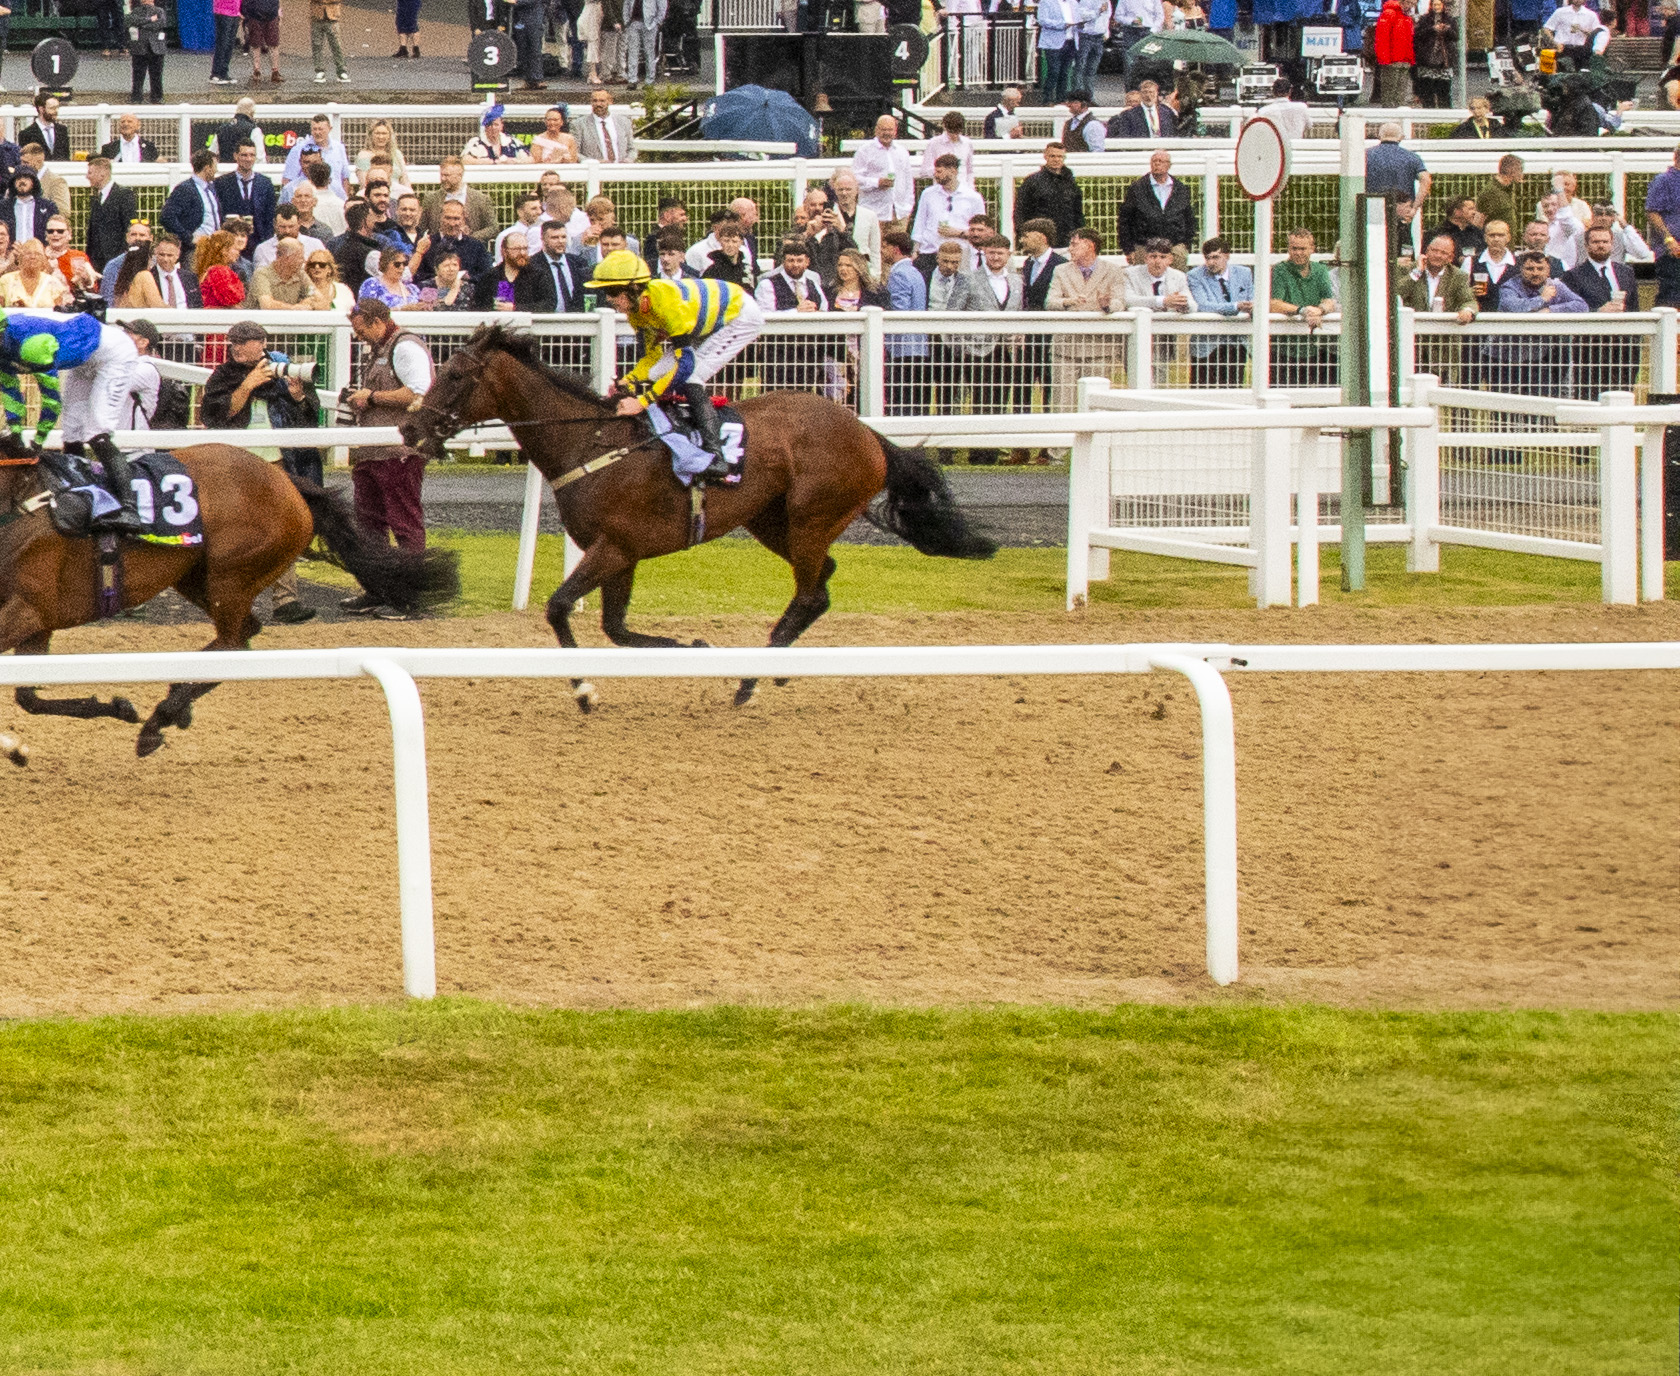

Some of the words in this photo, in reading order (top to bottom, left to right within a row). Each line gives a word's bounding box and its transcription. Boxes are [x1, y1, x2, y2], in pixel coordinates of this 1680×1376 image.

[894, 40, 911, 61] 4
[1305, 36, 1338, 48] MATT
[50, 54, 61, 74] 1
[483, 45, 501, 66] 3
[129, 473, 199, 527] 13
